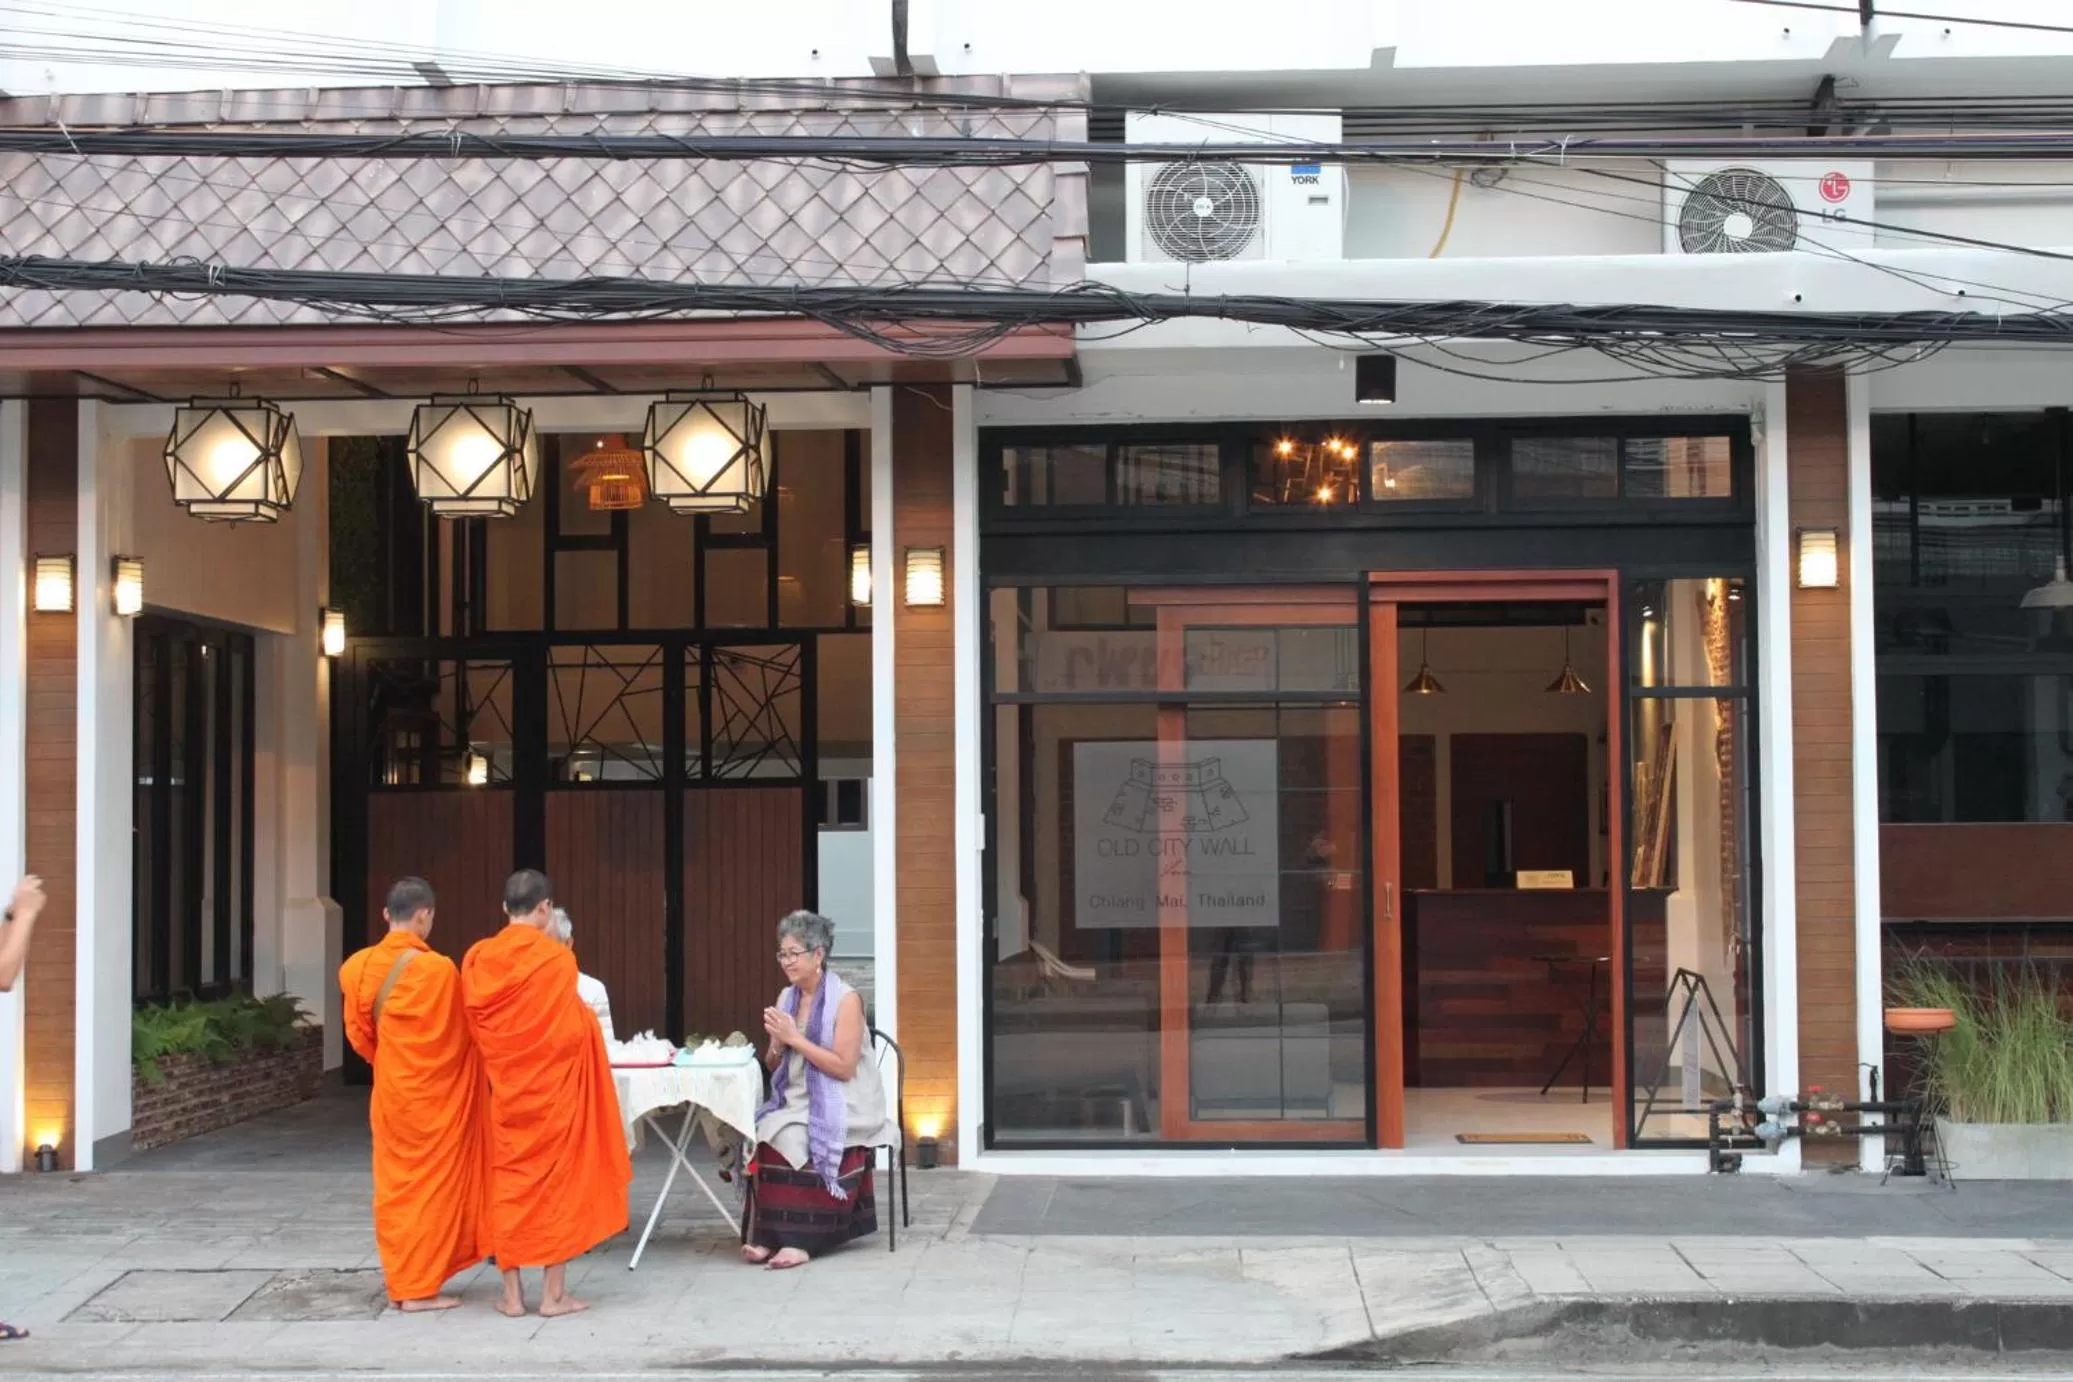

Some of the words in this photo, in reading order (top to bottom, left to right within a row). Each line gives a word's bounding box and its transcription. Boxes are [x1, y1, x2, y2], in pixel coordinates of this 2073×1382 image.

[1291, 175, 1319, 185] YORK
[1821, 208, 1848, 224] LG
[1097, 838, 1140, 857] OLD
[1147, 837, 1193, 857] CITY
[1200, 838, 1256, 856] WALL
[1089, 893, 1145, 911] Chiang
[1197, 892, 1267, 909] Thailand
